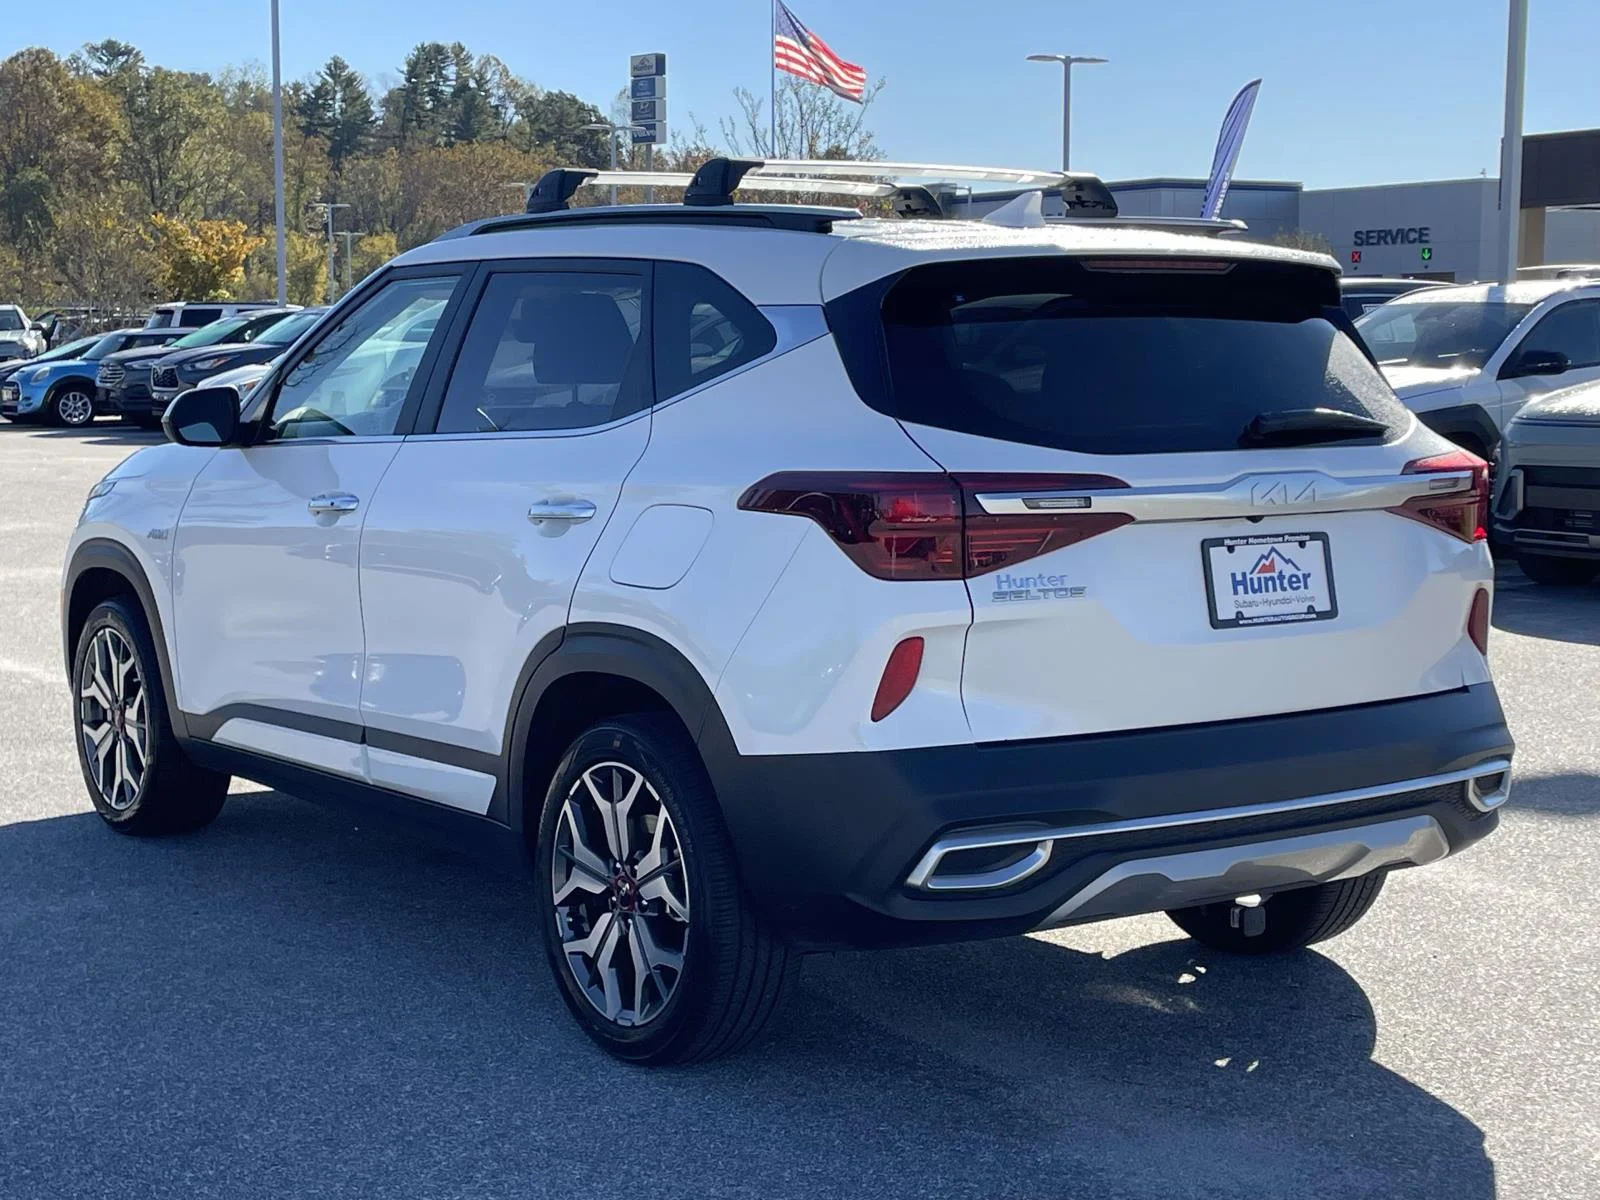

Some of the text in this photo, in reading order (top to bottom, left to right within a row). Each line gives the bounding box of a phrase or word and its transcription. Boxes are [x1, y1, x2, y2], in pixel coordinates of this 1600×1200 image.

[1354, 227, 1430, 246] SERVICE
[1250, 480, 1316, 506] KIA
[1224, 538, 1248, 546] Hunter
[995, 573, 1069, 590] Hunter
[1230, 570, 1311, 596] Hunter
[991, 586, 1088, 603] SELTOS
